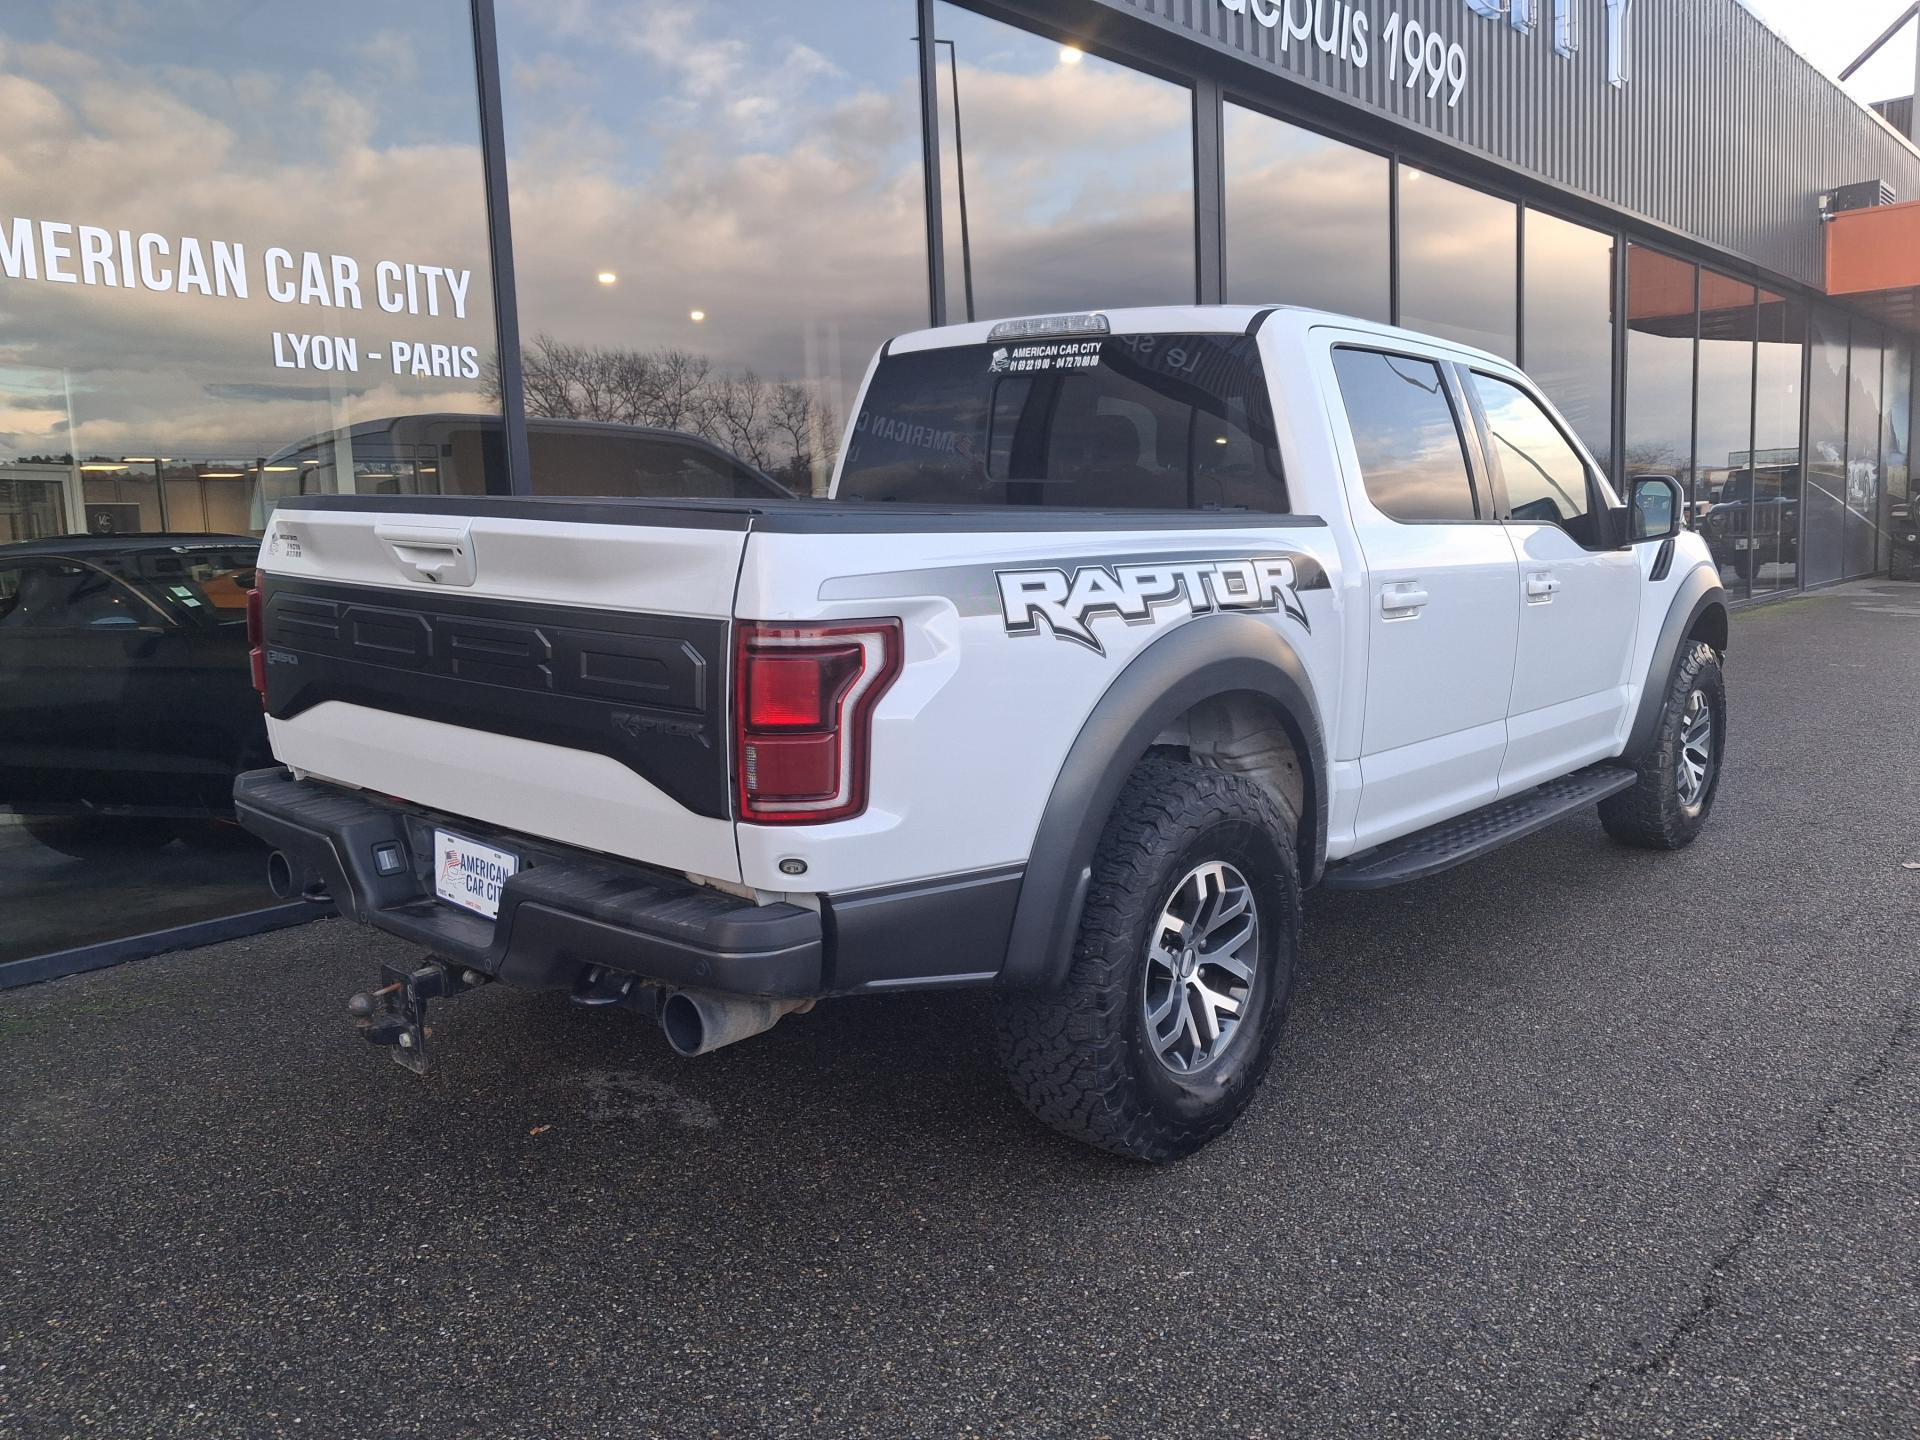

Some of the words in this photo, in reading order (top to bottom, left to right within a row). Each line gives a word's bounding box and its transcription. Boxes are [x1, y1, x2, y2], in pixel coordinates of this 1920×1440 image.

[1222, 0, 1368, 68] epuis
[1382, 12, 1467, 107] 1999
[264, 247, 362, 309] CAR
[376, 260, 471, 319] CITY
[272, 332, 358, 372] LYON
[391, 341, 480, 378] PARIS
[1012, 346, 1058, 358] AMERICAN
[1059, 344, 1079, 355] CAR
[1081, 342, 1102, 354] CITY
[1026, 359, 1034, 370] 22
[993, 556, 1311, 658] RAPTOR
[267, 591, 706, 714] FORD
[610, 711, 711, 749] RAPTOR
[460, 853, 509, 885] AMERICAN
[466, 874, 484, 898] CAR
